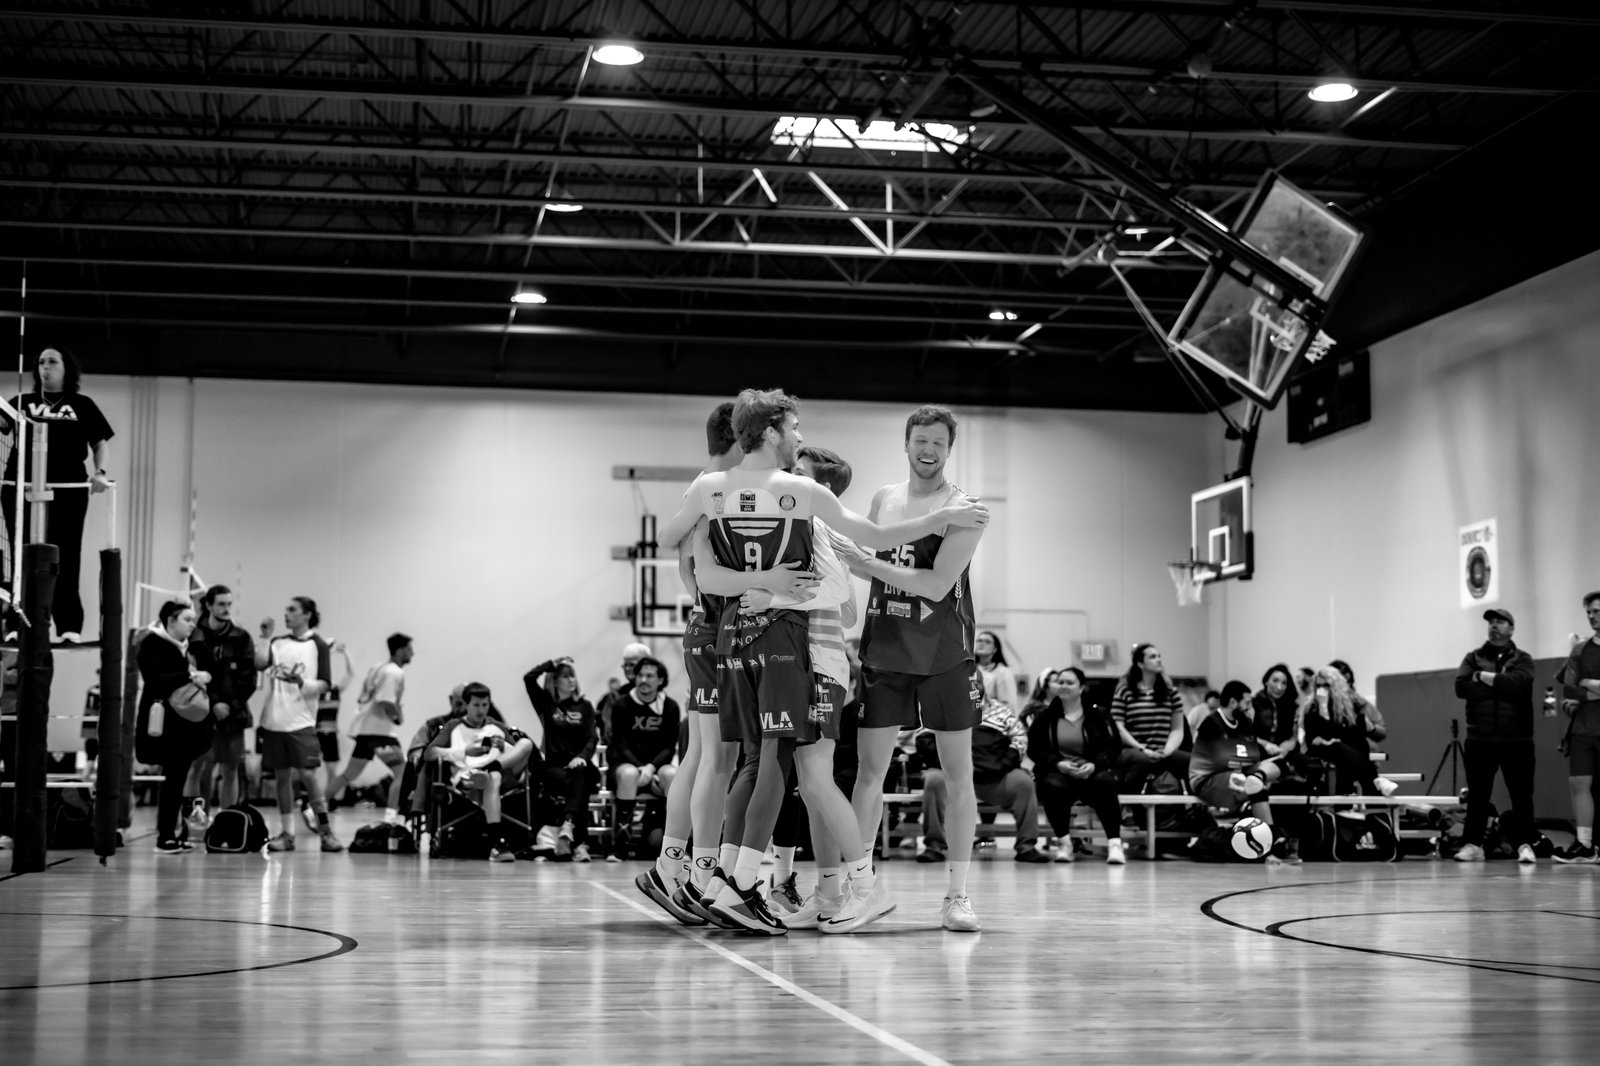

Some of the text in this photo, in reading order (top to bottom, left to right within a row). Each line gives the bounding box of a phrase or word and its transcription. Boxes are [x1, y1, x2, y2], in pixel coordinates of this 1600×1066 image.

[28, 402, 78, 420] VLA
[744, 541, 762, 572] 9
[887, 544, 916, 569] 35
[694, 687, 719, 705] VLA
[631, 715, 663, 731] X2
[759, 710, 794, 730] VLA
[1235, 743, 1249, 758] 2
